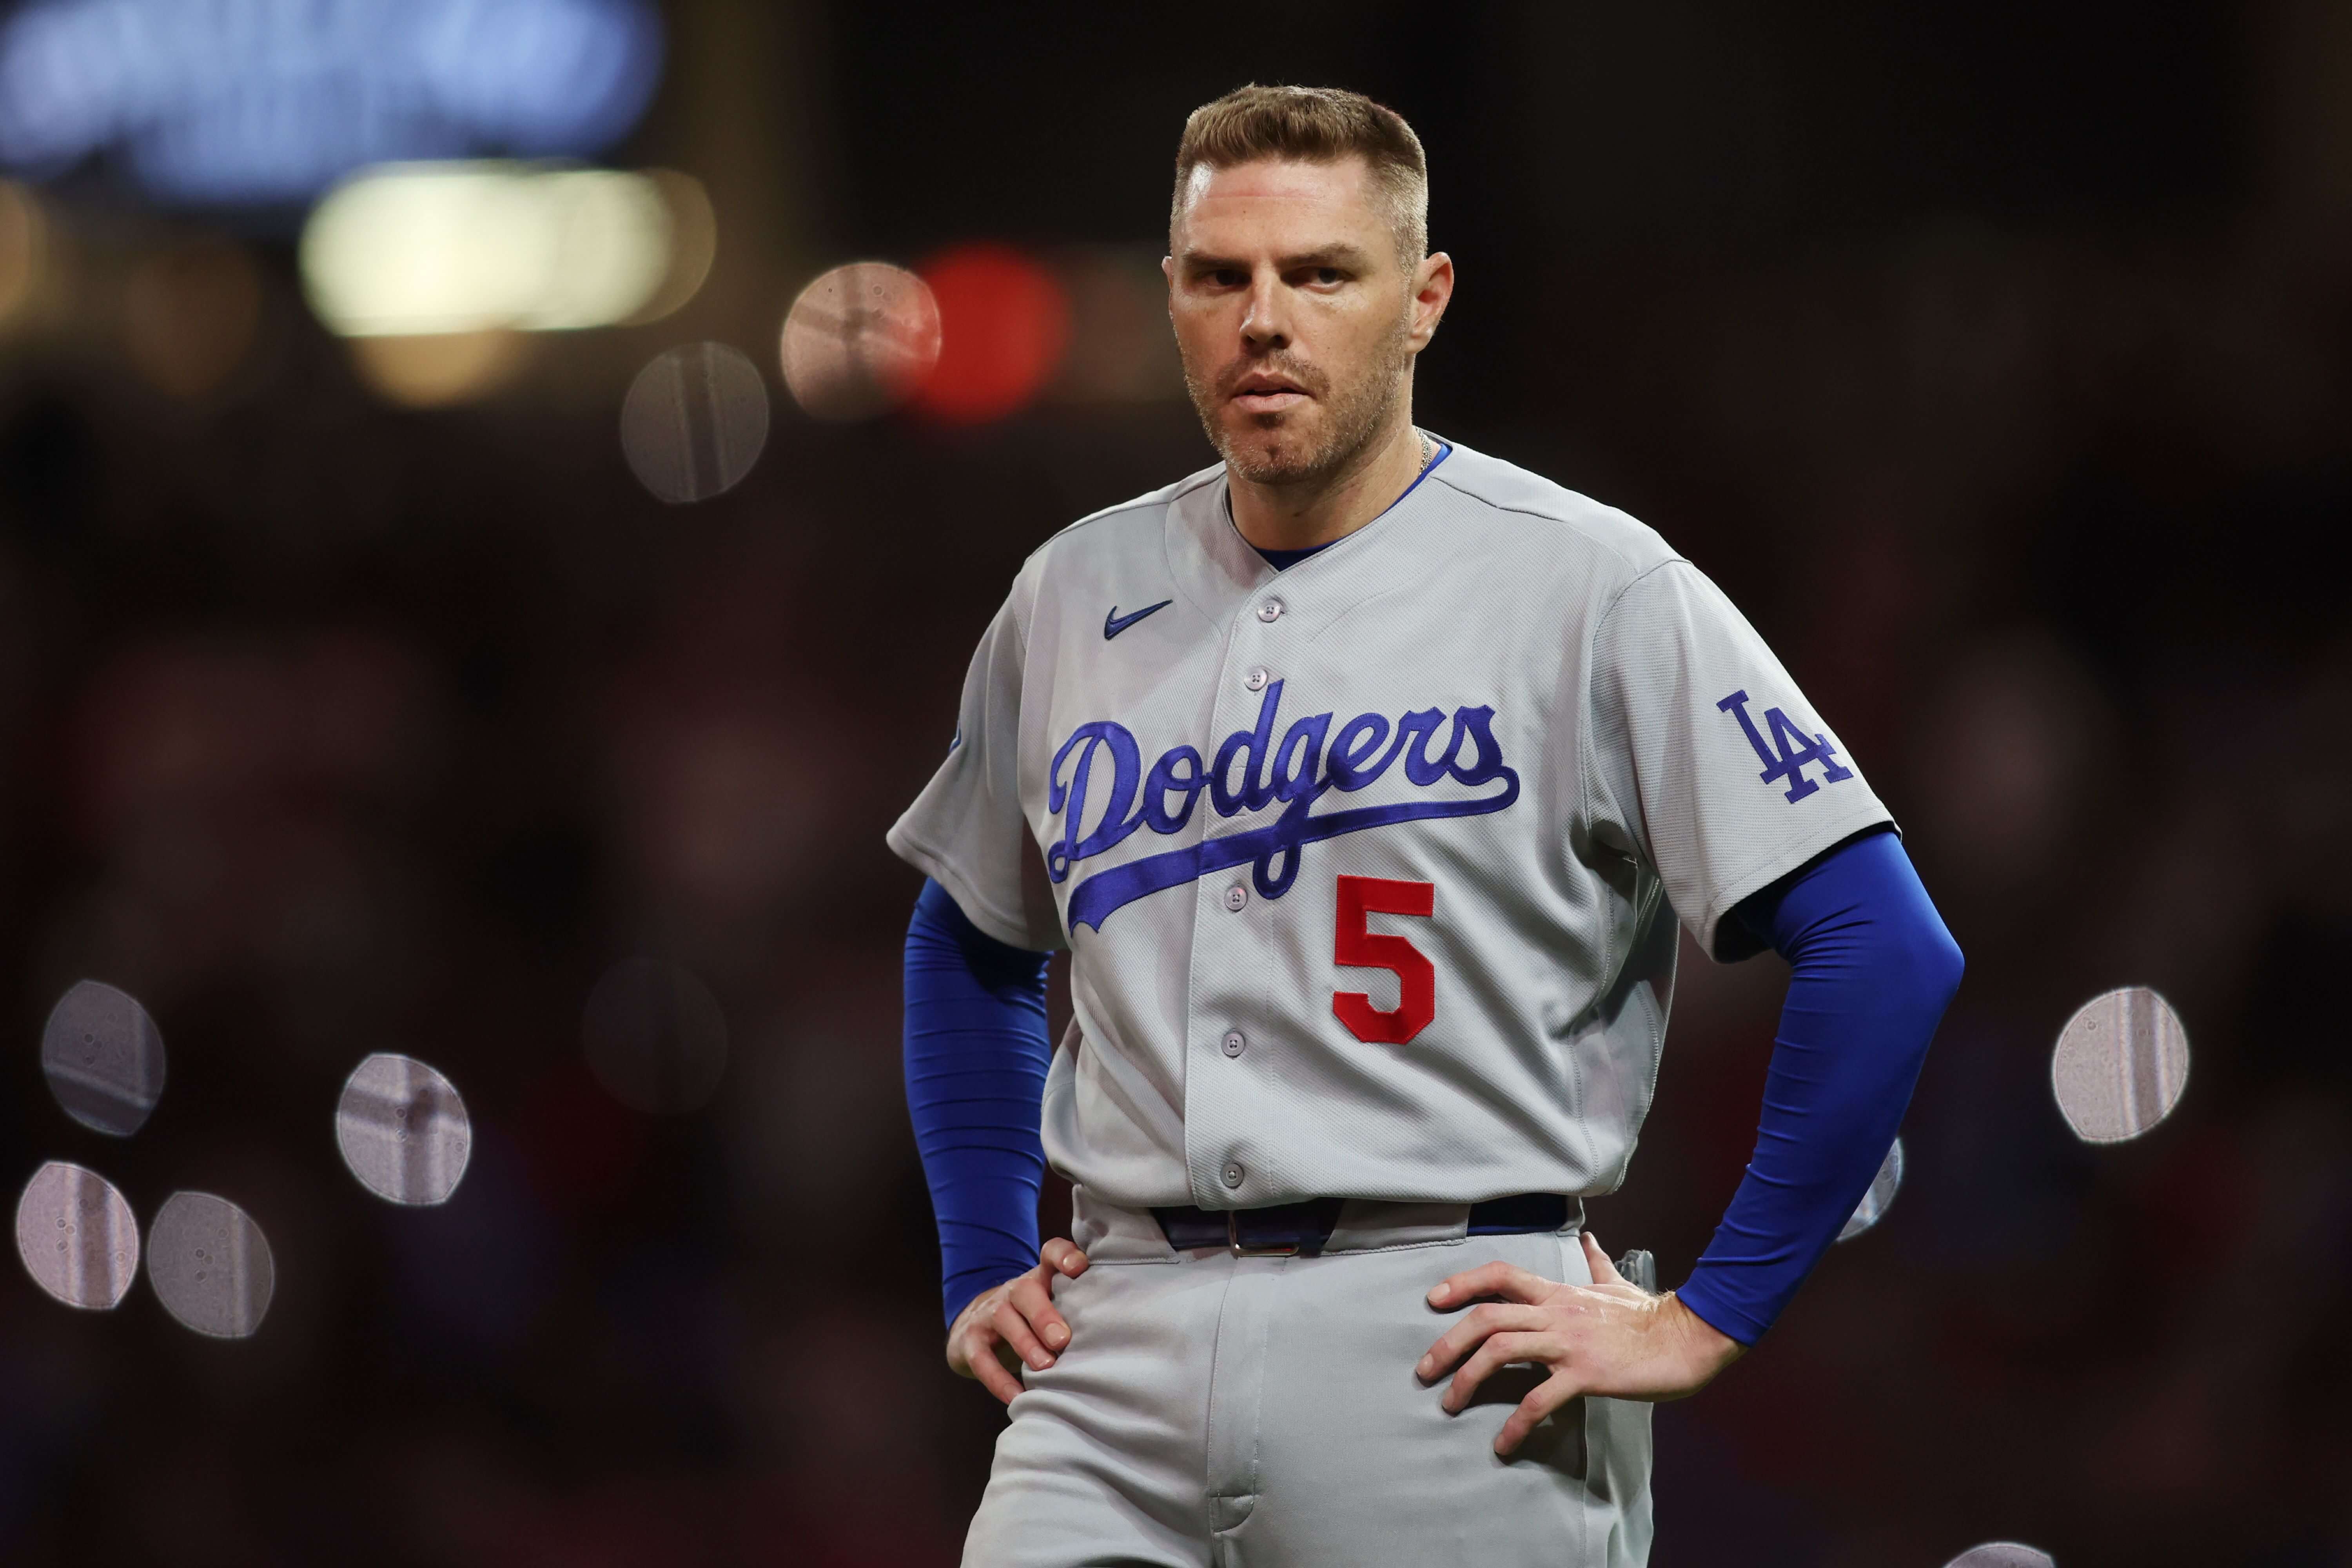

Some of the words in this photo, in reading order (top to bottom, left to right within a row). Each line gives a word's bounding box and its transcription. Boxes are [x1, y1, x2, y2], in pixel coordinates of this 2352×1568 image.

[1048, 678, 1520, 899] Dodgers
[1716, 690, 1854, 804] LA
[1334, 875, 1434, 1044] 5
